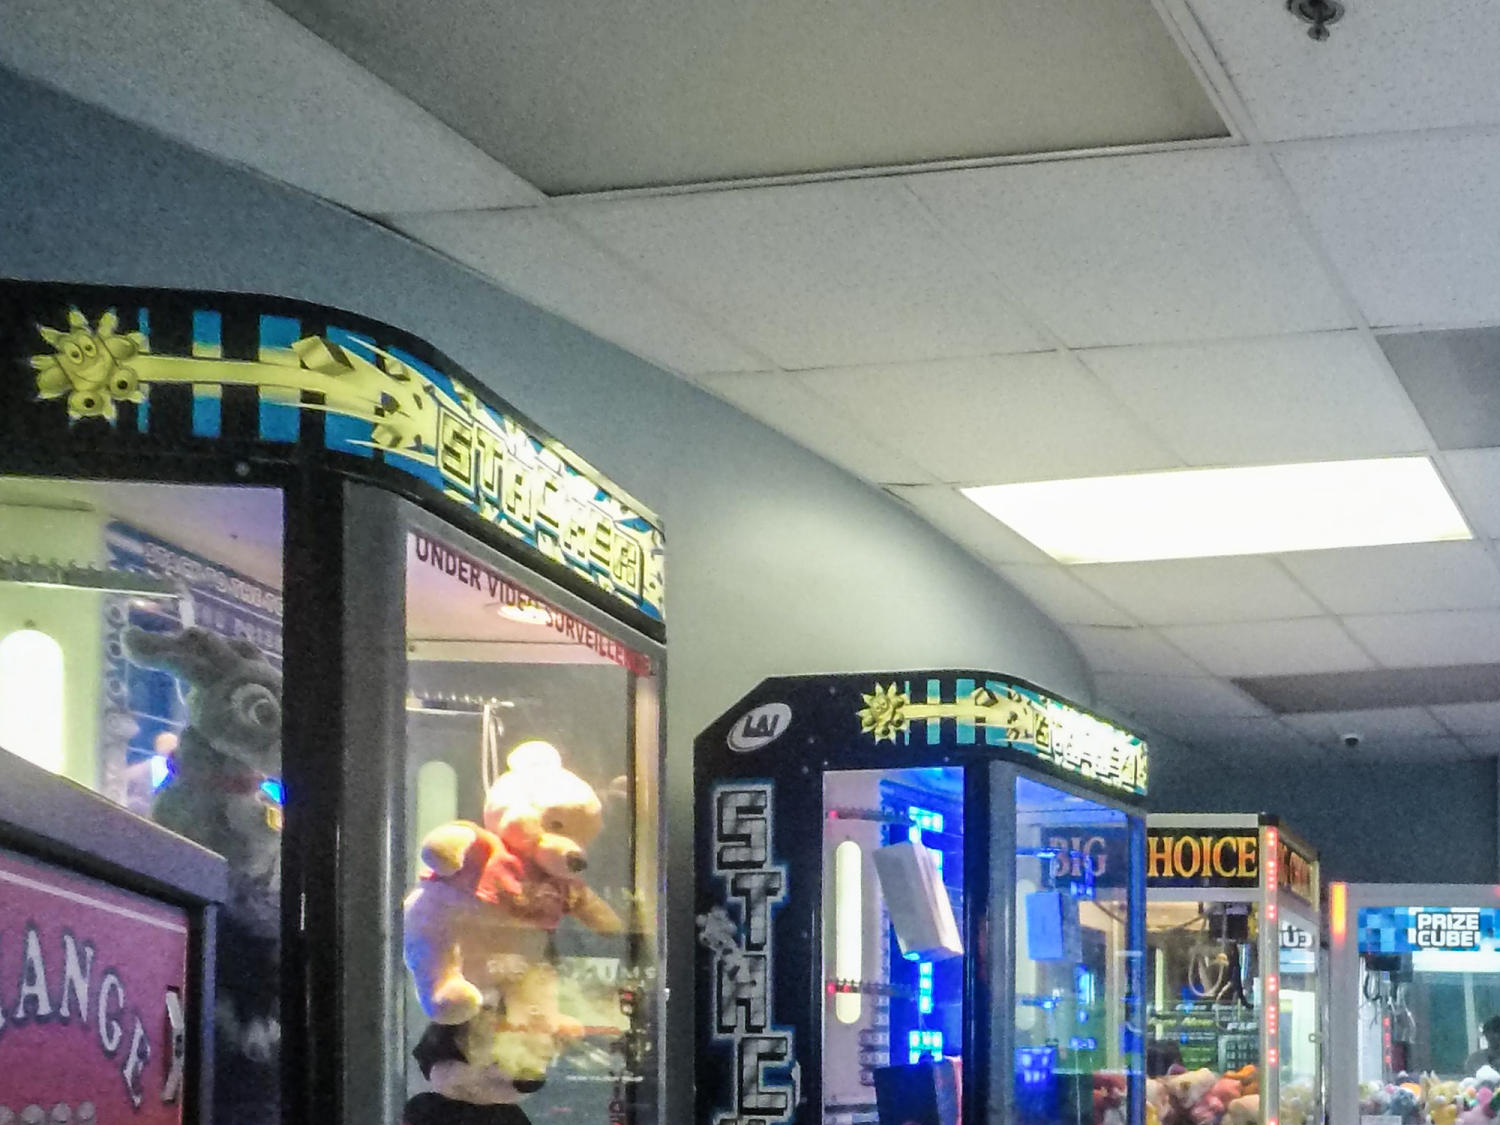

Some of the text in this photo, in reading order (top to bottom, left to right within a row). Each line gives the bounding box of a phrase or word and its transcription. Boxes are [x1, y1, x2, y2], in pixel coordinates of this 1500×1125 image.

[440, 408, 641, 600] STACKER
[415, 535, 482, 591] UNDER
[1050, 836, 1107, 877] BIG
[1146, 834, 1258, 878] HOICE
[1416, 912, 1480, 930] PRIZE
[1416, 929, 1475, 948] CUBE
[0, 926, 153, 1109] ANGE
